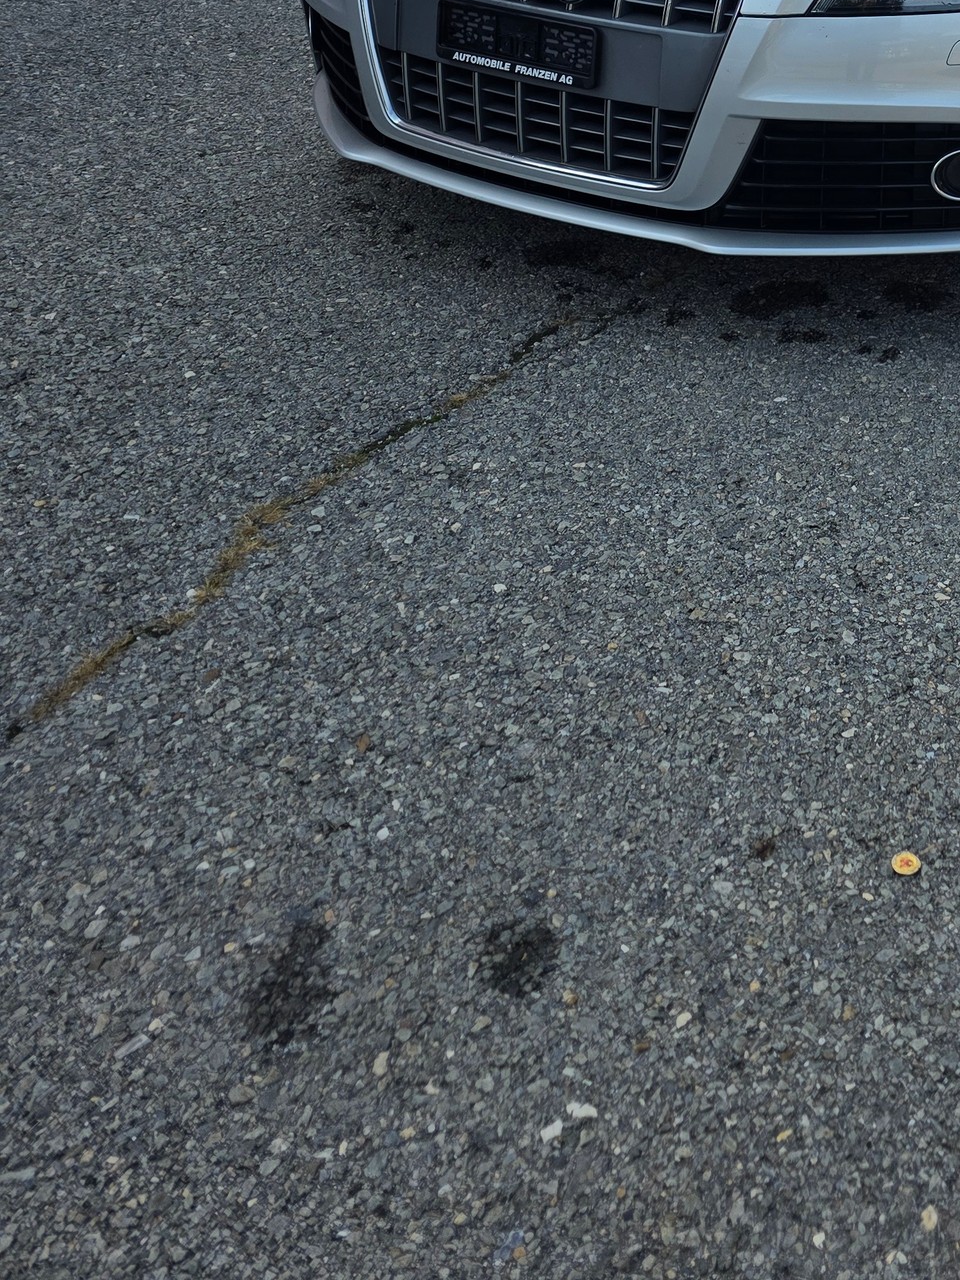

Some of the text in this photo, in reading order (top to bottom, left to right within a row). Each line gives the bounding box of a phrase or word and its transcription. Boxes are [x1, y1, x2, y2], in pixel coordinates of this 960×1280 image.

[452, 51, 573, 85] AUTOMOBILE FRANZEN AG
